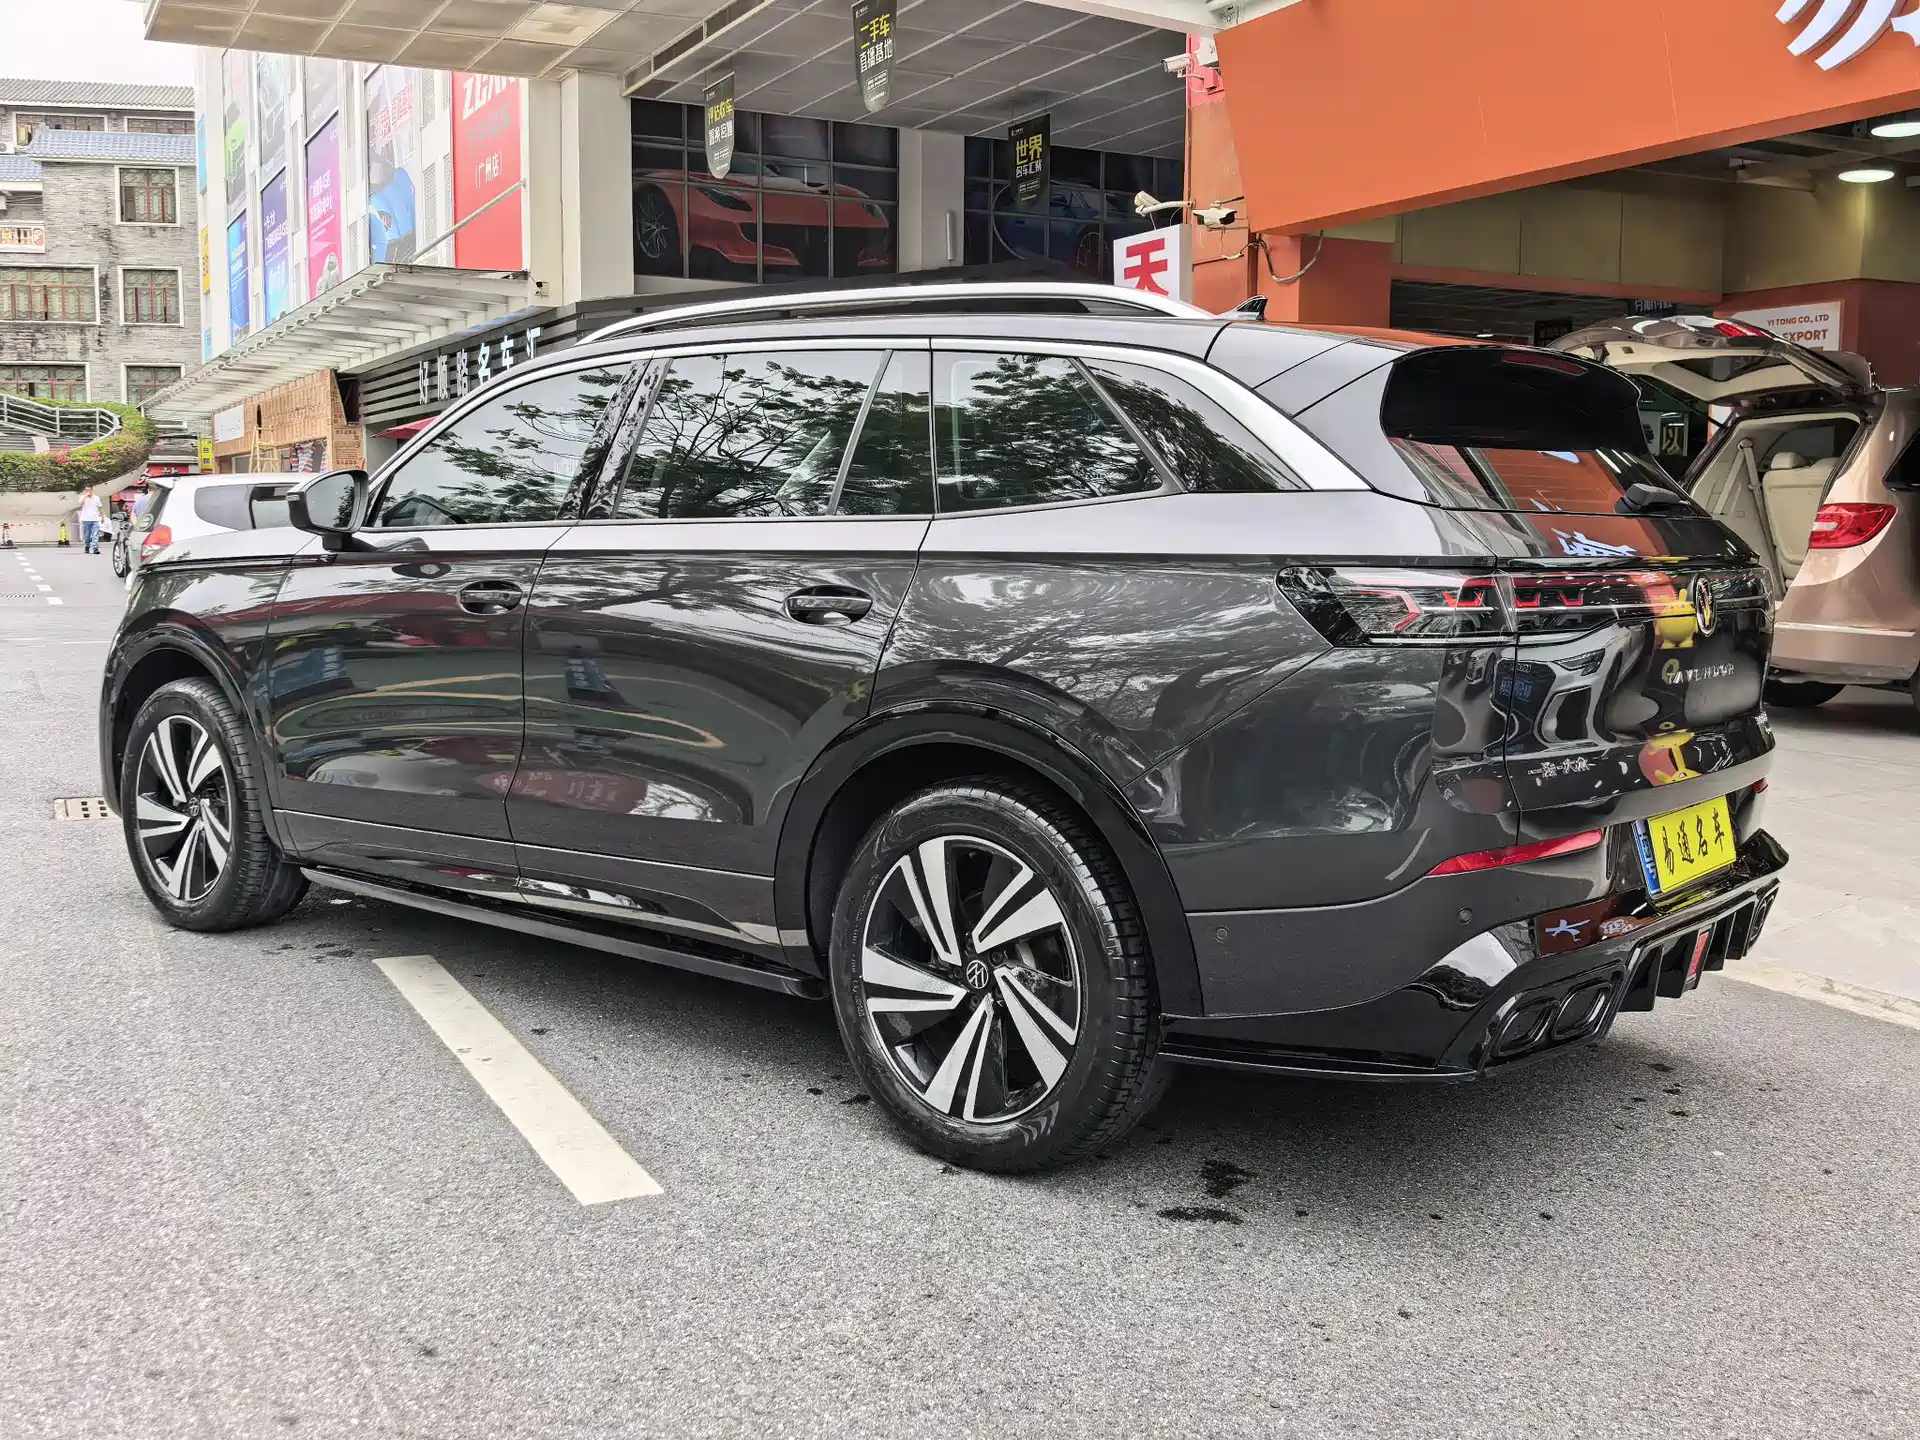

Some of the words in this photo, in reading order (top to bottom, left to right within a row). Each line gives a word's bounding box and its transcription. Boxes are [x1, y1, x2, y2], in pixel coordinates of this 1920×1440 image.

[860, 13, 890, 49] 二手车
[860, 37, 893, 73] 直播基地
[1016, 134, 1043, 165] 世界
[1767, 319, 1775, 327] YI
[1776, 316, 1797, 326] TONG
[1815, 313, 1830, 322] LTD
[1661, 806, 1725, 876] 易通名车
